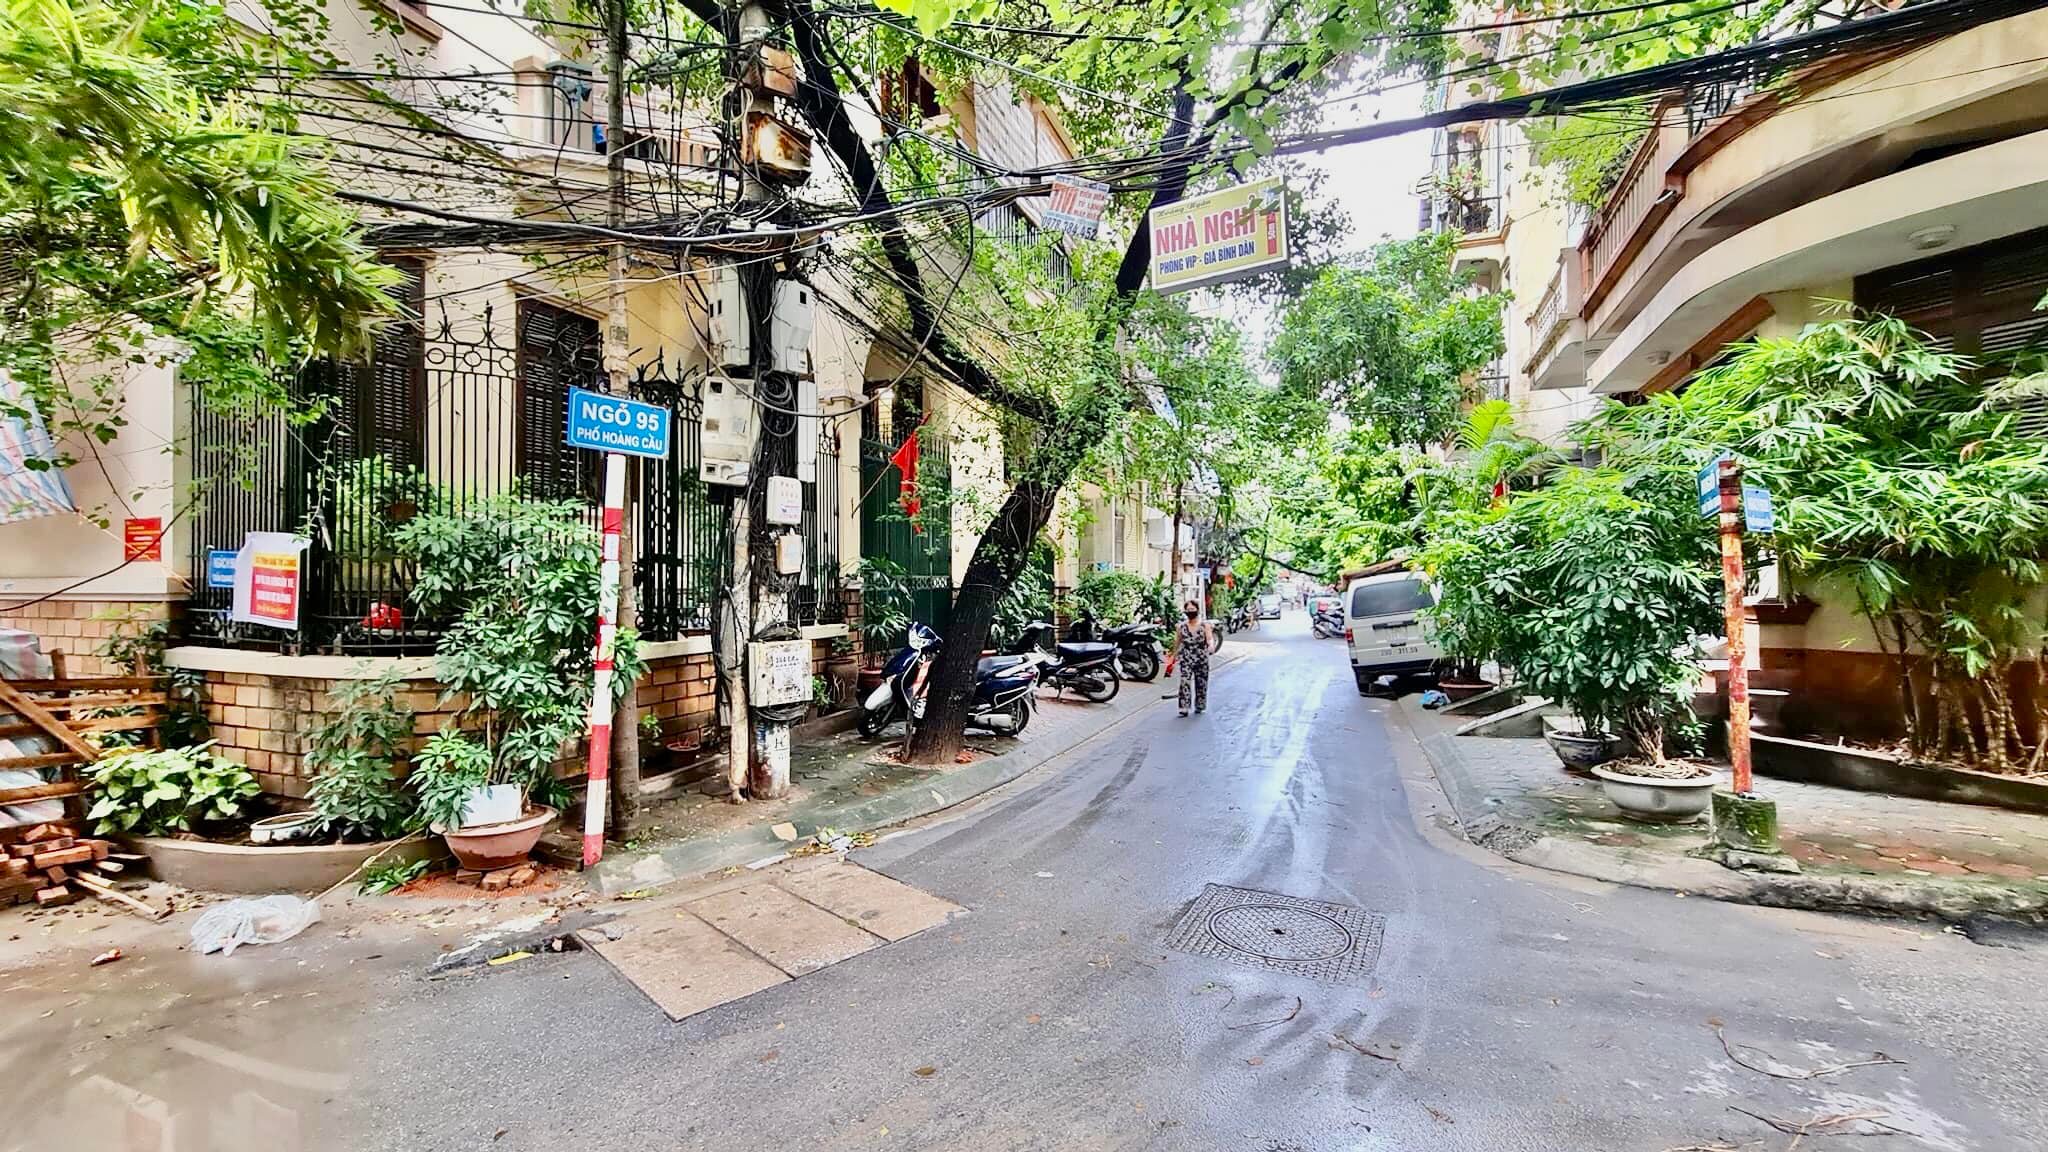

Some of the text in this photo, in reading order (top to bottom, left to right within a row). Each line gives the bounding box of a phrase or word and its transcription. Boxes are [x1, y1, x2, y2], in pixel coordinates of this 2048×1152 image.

[1155, 193, 1256, 256] NHÀ NGHỈ
[1185, 255, 1197, 269] VIP
[1238, 240, 1255, 257] DÂN
[582, 401, 660, 432] NGÕ 95
[577, 425, 663, 450] PHỐ HOÀNG CẦU
